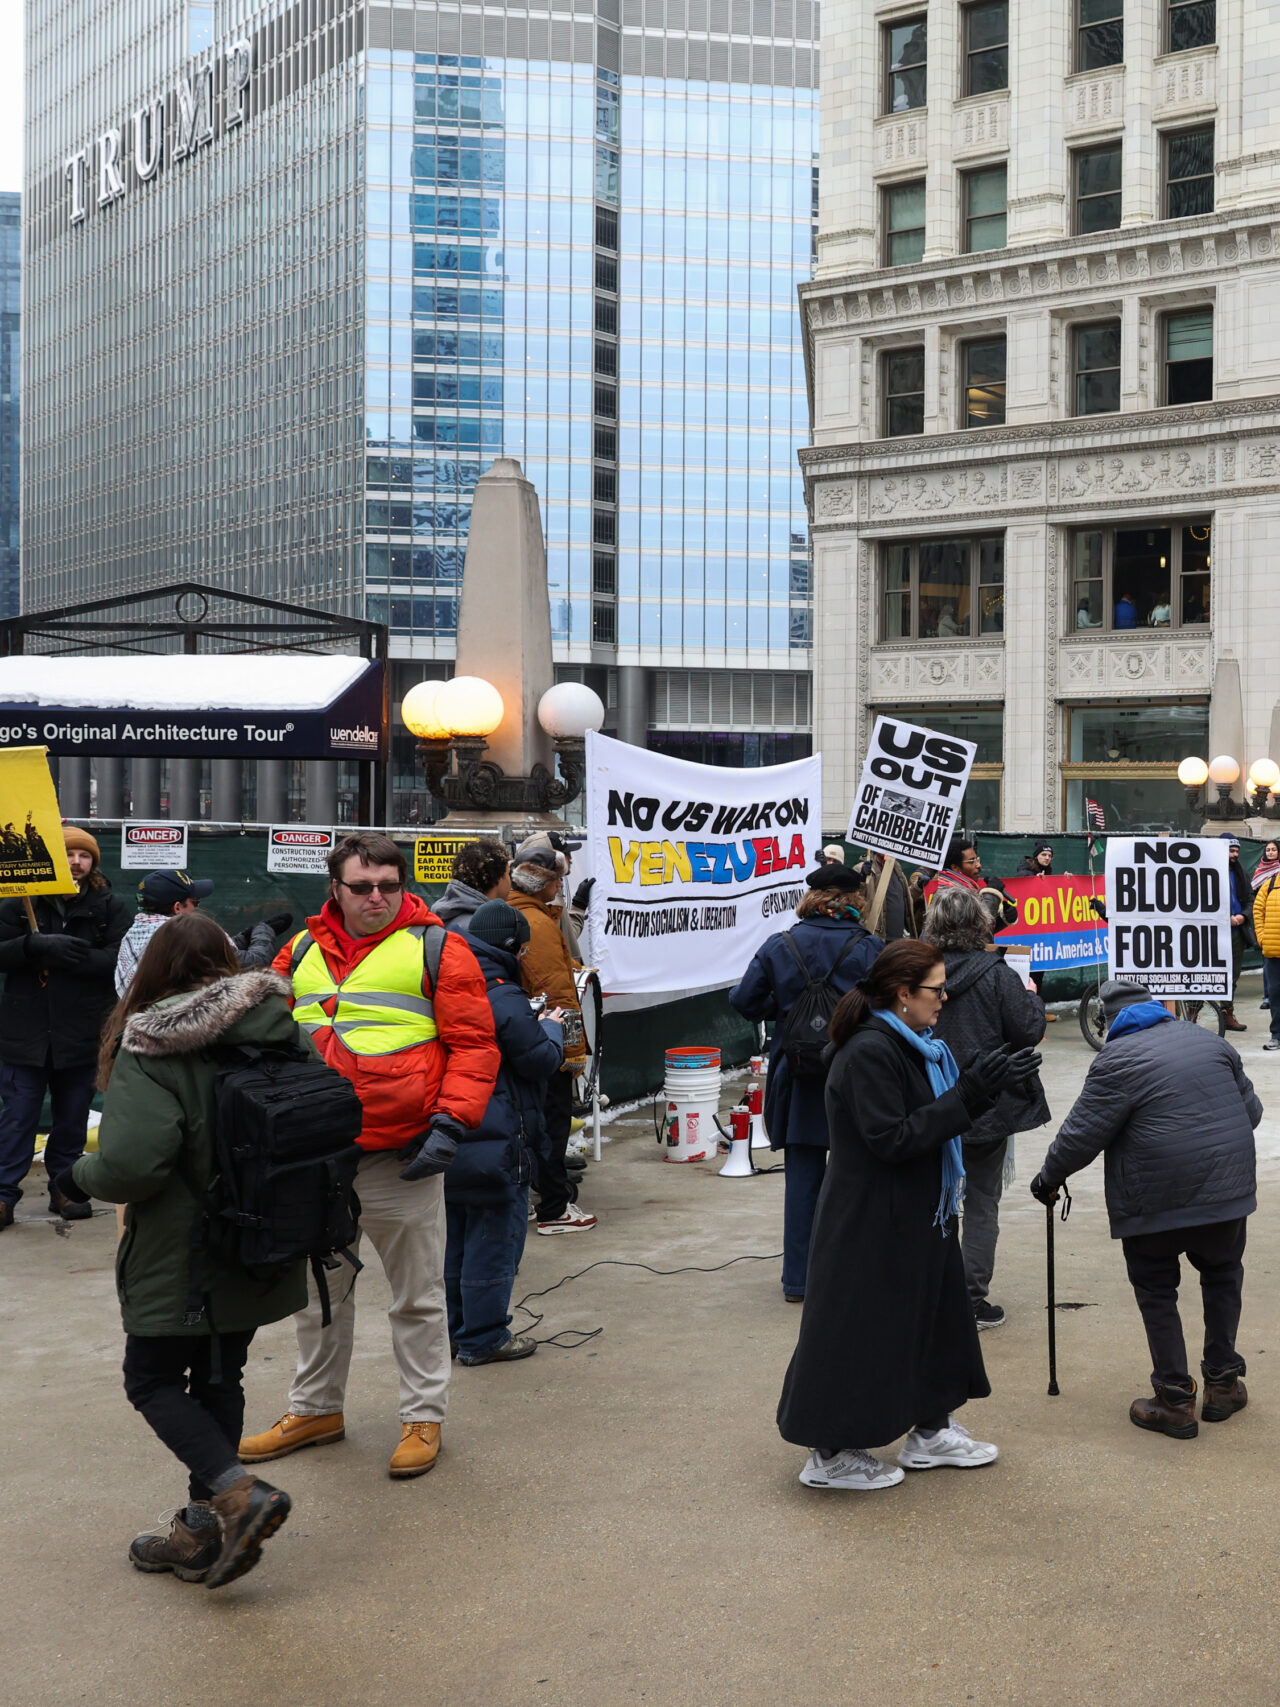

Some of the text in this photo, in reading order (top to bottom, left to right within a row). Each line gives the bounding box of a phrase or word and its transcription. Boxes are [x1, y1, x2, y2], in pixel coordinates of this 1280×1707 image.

[65, 37, 251, 226] TRUMP
[43, 723, 117, 744] Original
[121, 723, 238, 742] Architecture
[330, 726, 374, 742] wendella
[878, 722, 968, 773] US
[870, 757, 962, 798] OUT
[607, 790, 809, 835] NO US WAR ON
[861, 784, 953, 827] OF THE
[131, 830, 178, 841] DANGER
[281, 833, 322, 843] DANGER
[855, 805, 947, 850] CARIBBEAN
[272, 848, 316, 856] CONSTRUCTION
[607, 834, 806, 886] VENEZUELA
[852, 831, 940, 863] PARTY FOR SOCIALISM & LIBERATION
[1134, 842, 1201, 864] NO
[13, 867, 53, 876] REFUSE
[1115, 867, 1221, 913] BLOOD
[604, 905, 737, 938] PARTY FOR SOCIALISM & LIBERATION
[1024, 896, 1056, 926] on
[1055, 941, 1094, 960] America
[1094, 937, 1103, 955] &
[1115, 925, 1227, 969] FOR OIL
[1136, 974, 1149, 983] FOR
[1148, 974, 1182, 983] SOCIALISM
[1182, 974, 1191, 983] &
[1191, 974, 1226, 983] LIBERATION
